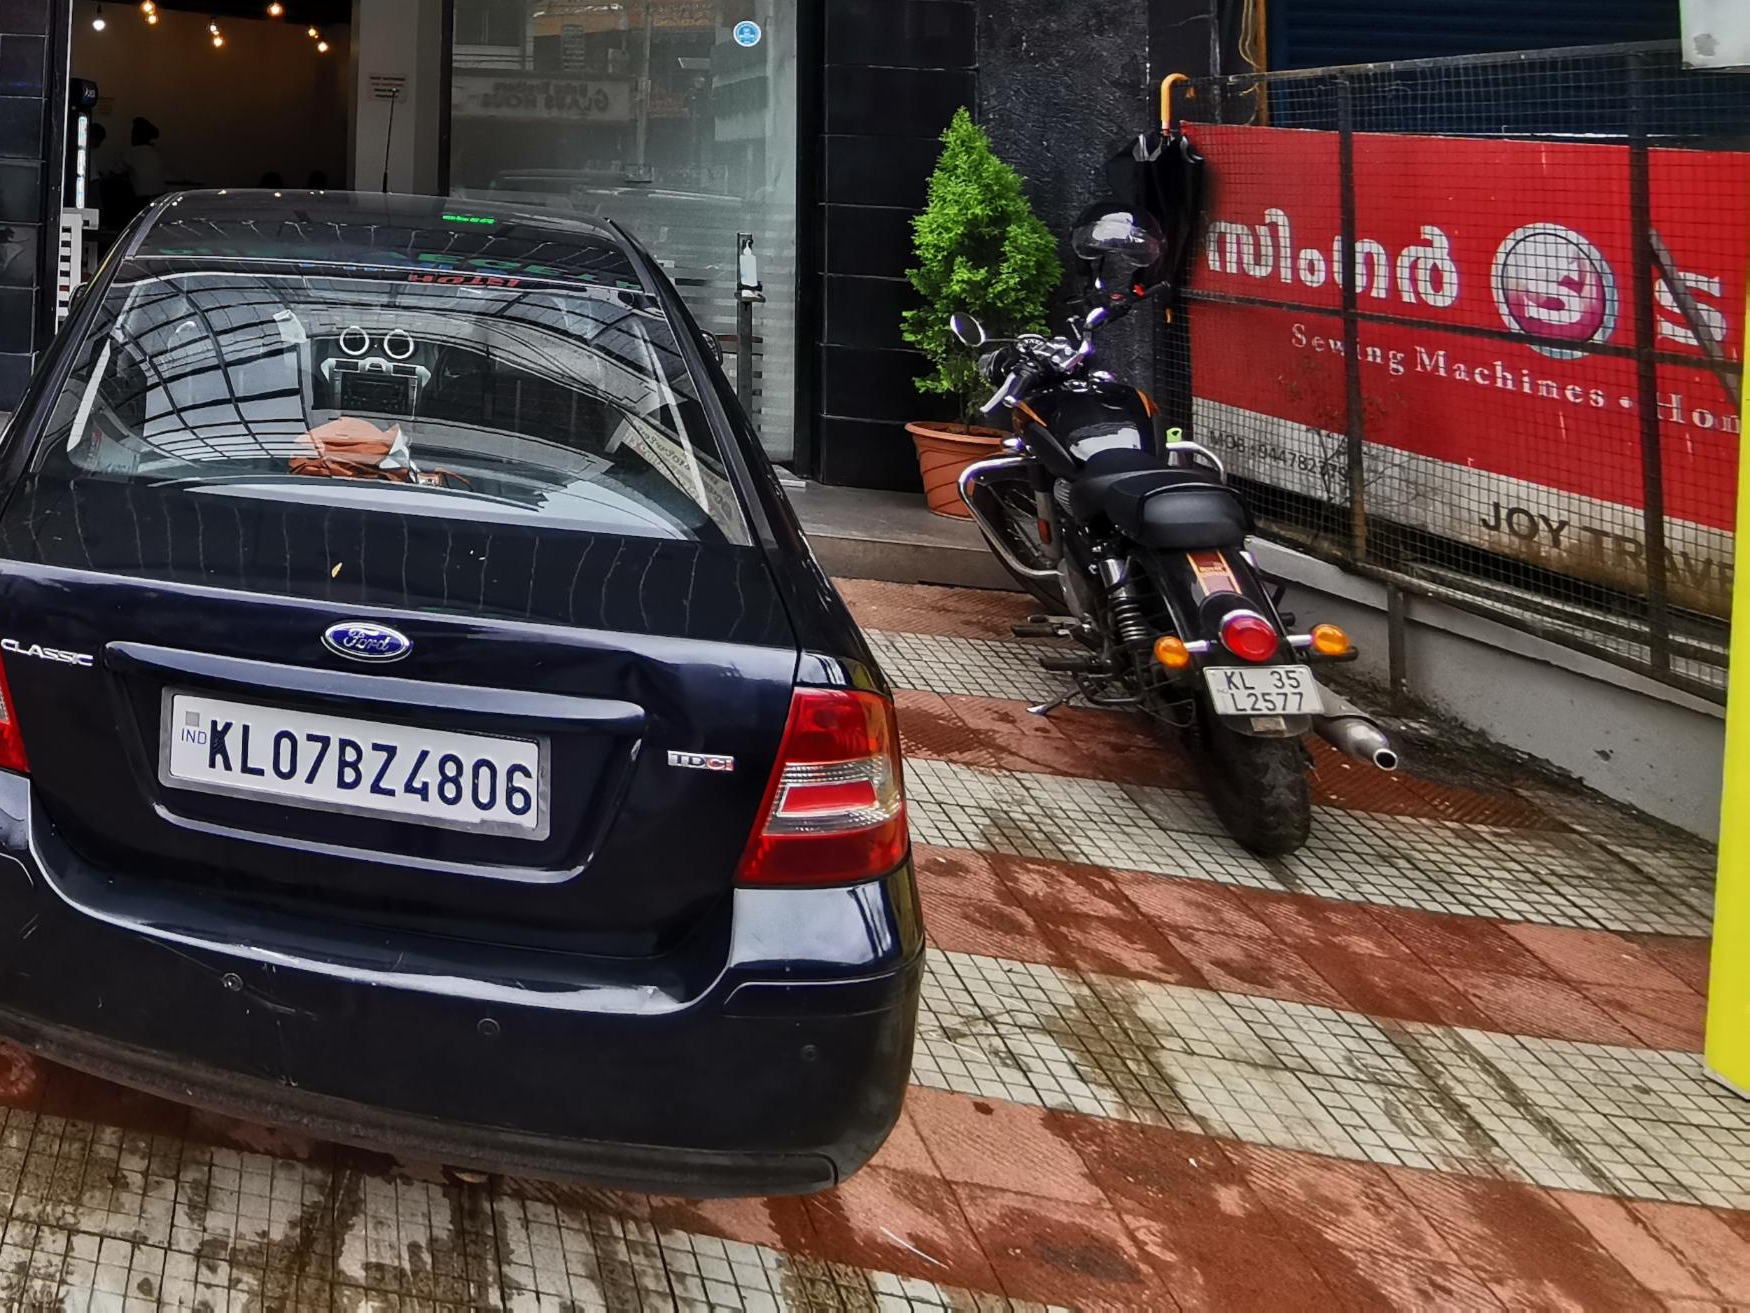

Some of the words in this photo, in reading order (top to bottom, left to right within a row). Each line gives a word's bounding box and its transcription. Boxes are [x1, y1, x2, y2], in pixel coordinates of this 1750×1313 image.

[1292, 323, 1405, 376] Sewing
[1414, 345, 1606, 409] Machines
[1481, 501, 1569, 549] JOY
[0, 638, 94, 667] CLASSIC
[343, 628, 391, 651] Ford
[1224, 671, 1256, 691] KL
[1270, 670, 1301, 689] 35
[1230, 692, 1304, 712] L2577
[181, 727, 208, 746] IND
[207, 718, 534, 816] KL07BZ4806
